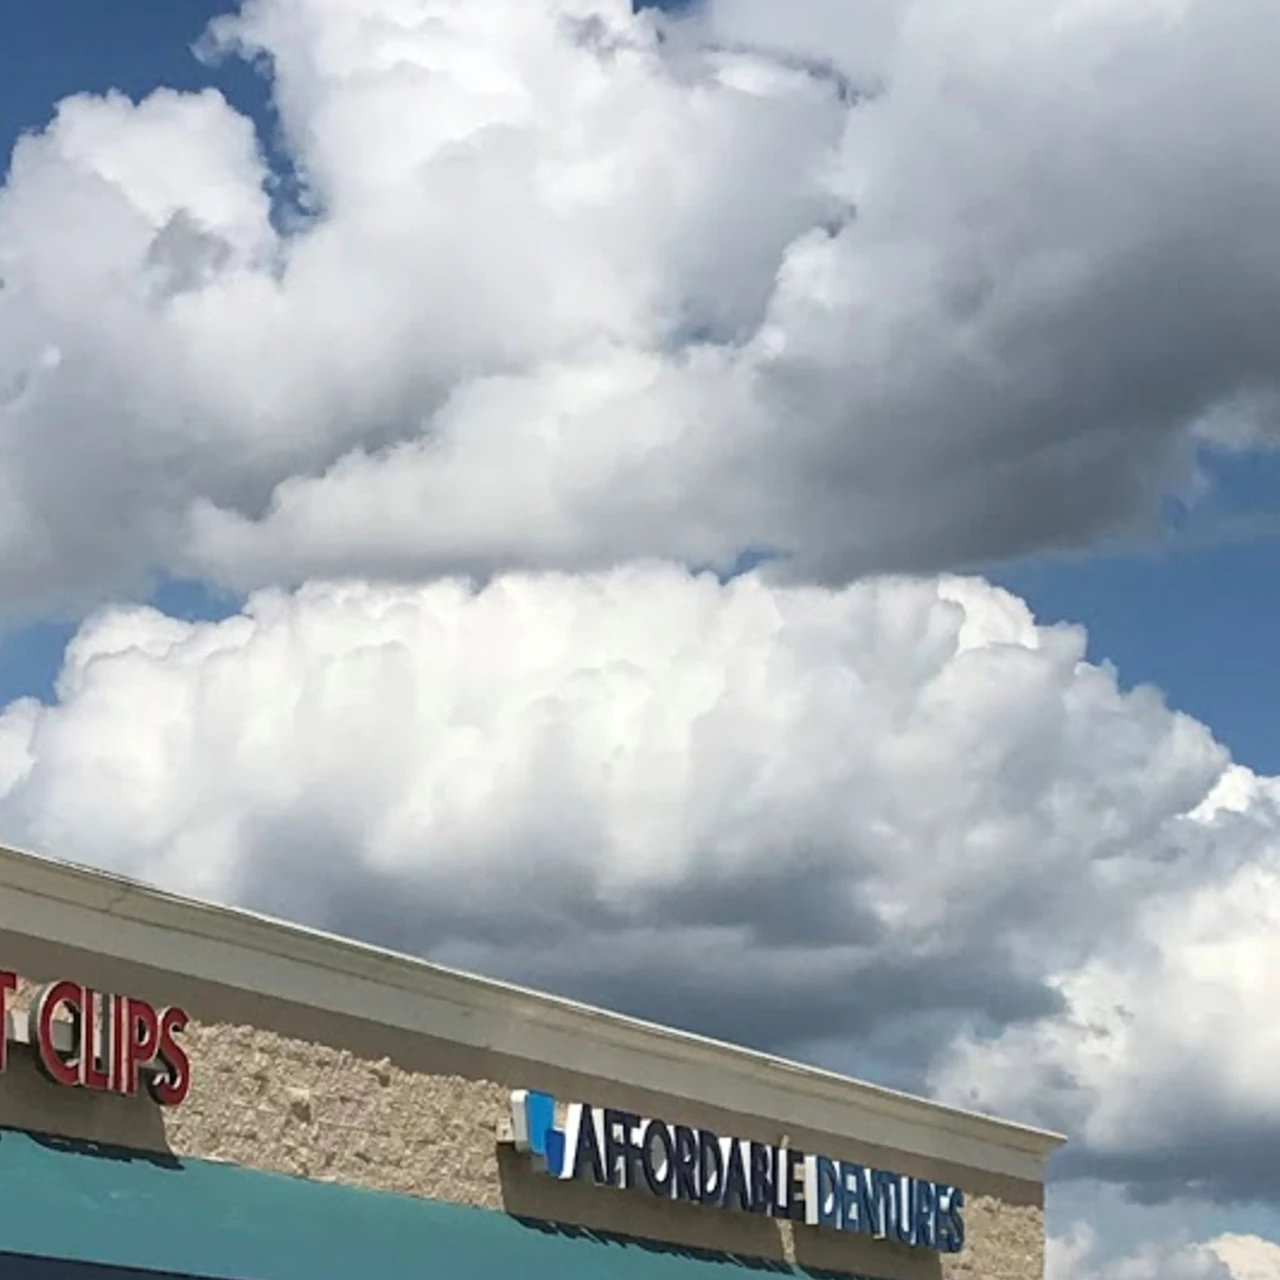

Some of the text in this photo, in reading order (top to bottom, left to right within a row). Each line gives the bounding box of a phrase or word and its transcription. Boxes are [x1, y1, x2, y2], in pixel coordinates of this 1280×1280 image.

[36, 979, 191, 1107] CLIPS
[560, 1103, 965, 1253] AFFORDABLE DENTURES
